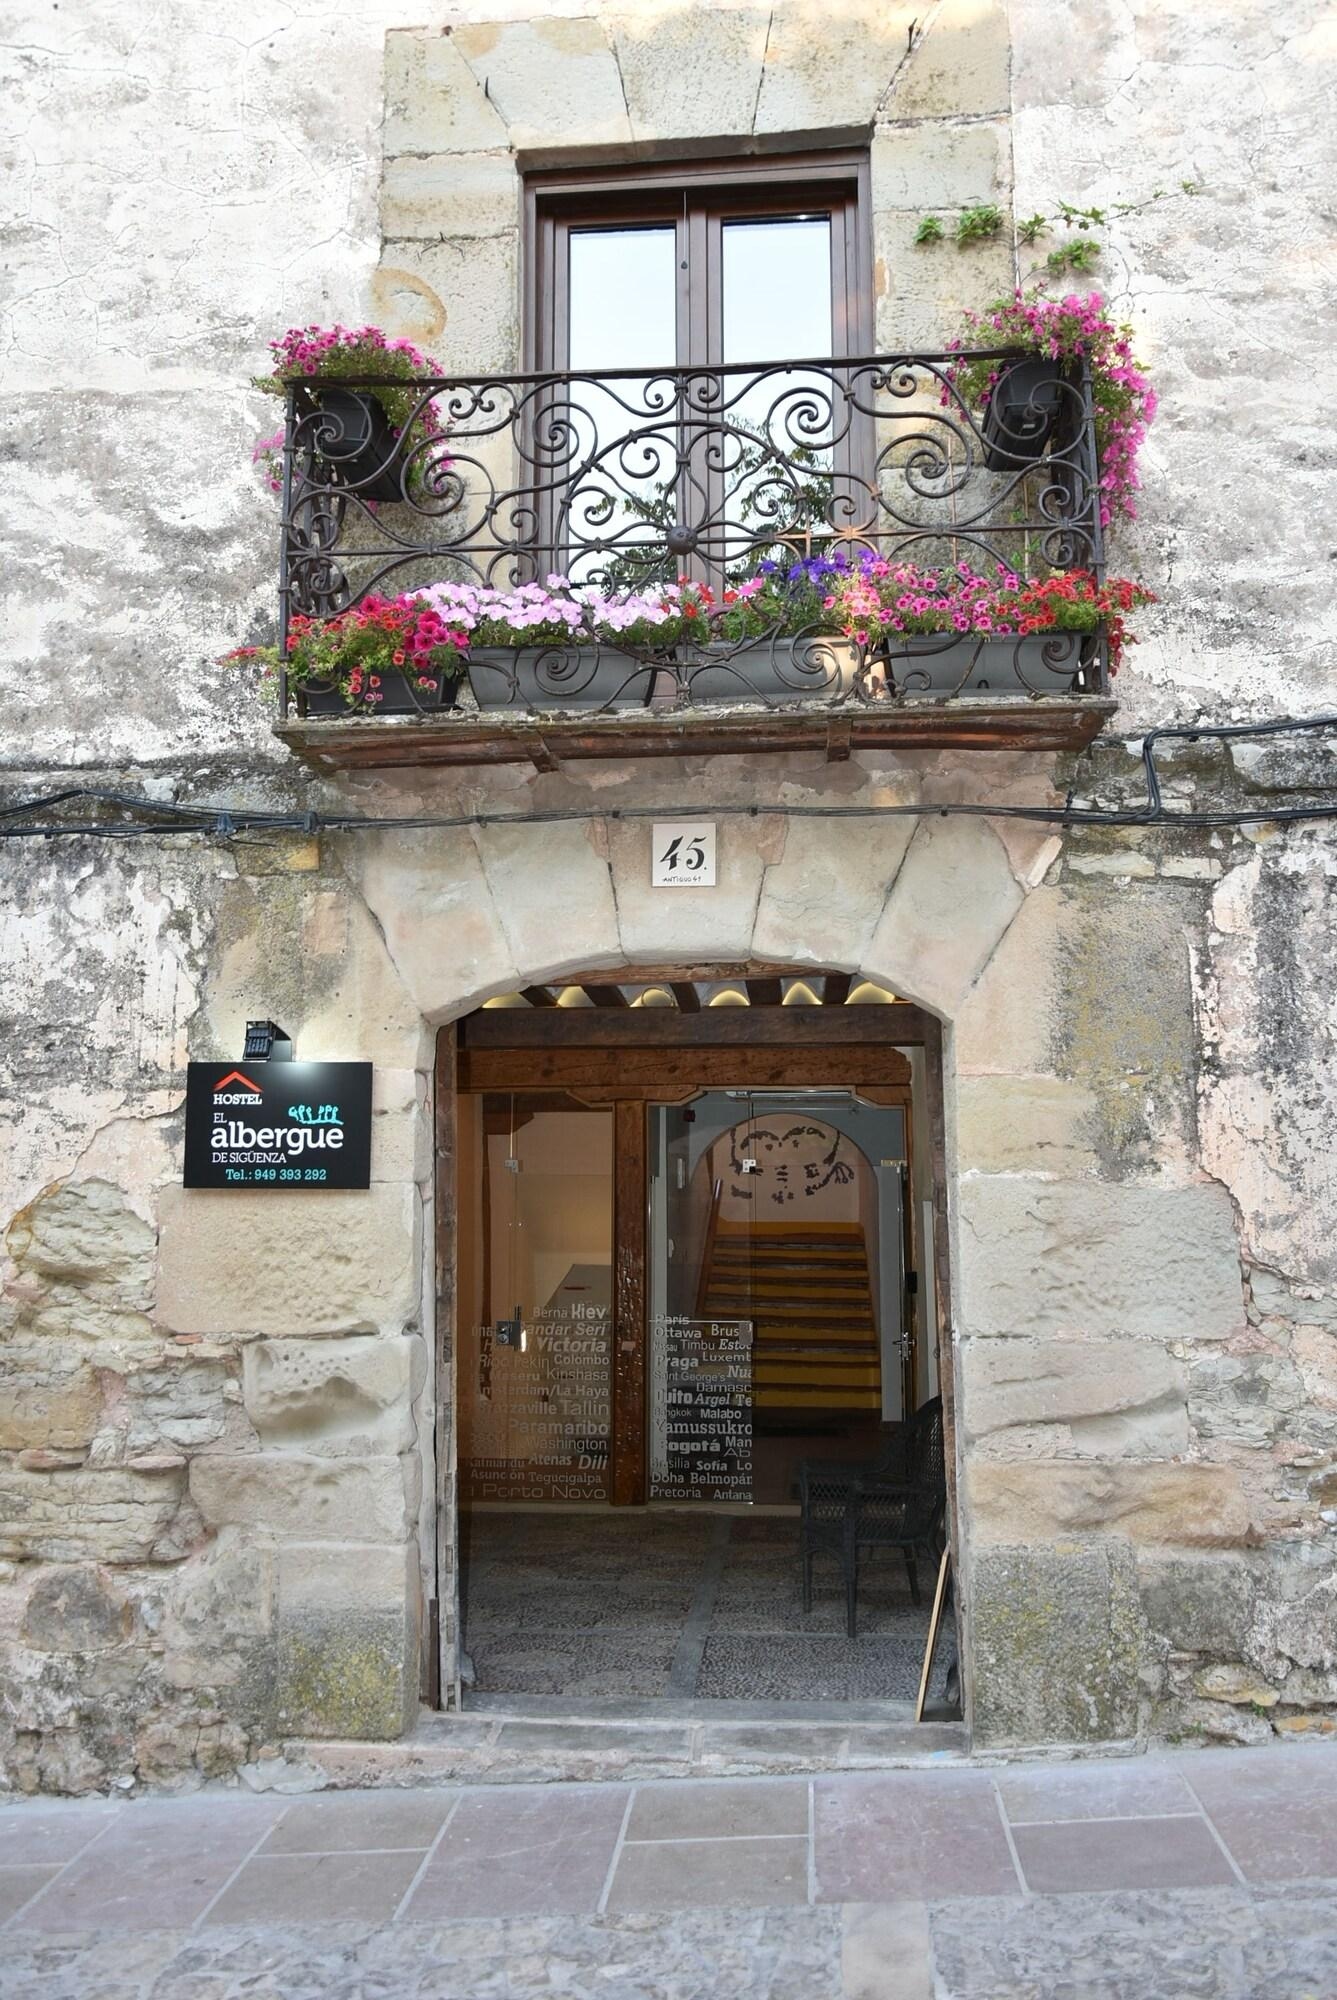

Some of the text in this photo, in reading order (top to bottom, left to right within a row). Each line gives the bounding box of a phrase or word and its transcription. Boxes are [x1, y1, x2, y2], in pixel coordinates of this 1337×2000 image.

[213, 1093, 263, 1105] HOSTEL
[213, 1112, 227, 1124] EL
[210, 1121, 344, 1156] albergue
[212, 1151, 287, 1164] DE SIGÜENZA
[225, 1169, 327, 1180] Tel.: 949 393 292
[533, 1303, 607, 1320] Berna Kiev
[520, 1321, 606, 1337] andar Seri
[654, 1327, 702, 1339] Ottawa
[536, 1338, 607, 1353] Victoria
[554, 1354, 610, 1366] Colombo
[654, 1355, 699, 1371] Praga
[546, 1368, 609, 1382] Kinshasa
[575, 1384, 609, 1400] Haya
[561, 1399, 609, 1416] Tallin
[693, 1392, 731, 1408] Argel
[700, 1408, 742, 1420] Malabo
[508, 1418, 609, 1436] Paramaribo
[655, 1419, 752, 1435] Yamussukro
[525, 1437, 607, 1453] Washington
[658, 1435, 752, 1454] Bogotá Man
[528, 1454, 572, 1466] Atenas
[578, 1454, 609, 1470] Dili
[736, 1460, 752, 1471] Lo
[528, 1471, 602, 1486] Tegucigalpa
[651, 1471, 685, 1483] Doha
[482, 1483, 544, 1499] Porto
[551, 1484, 607, 1500] Novo
[650, 1485, 702, 1498] Pretoria
